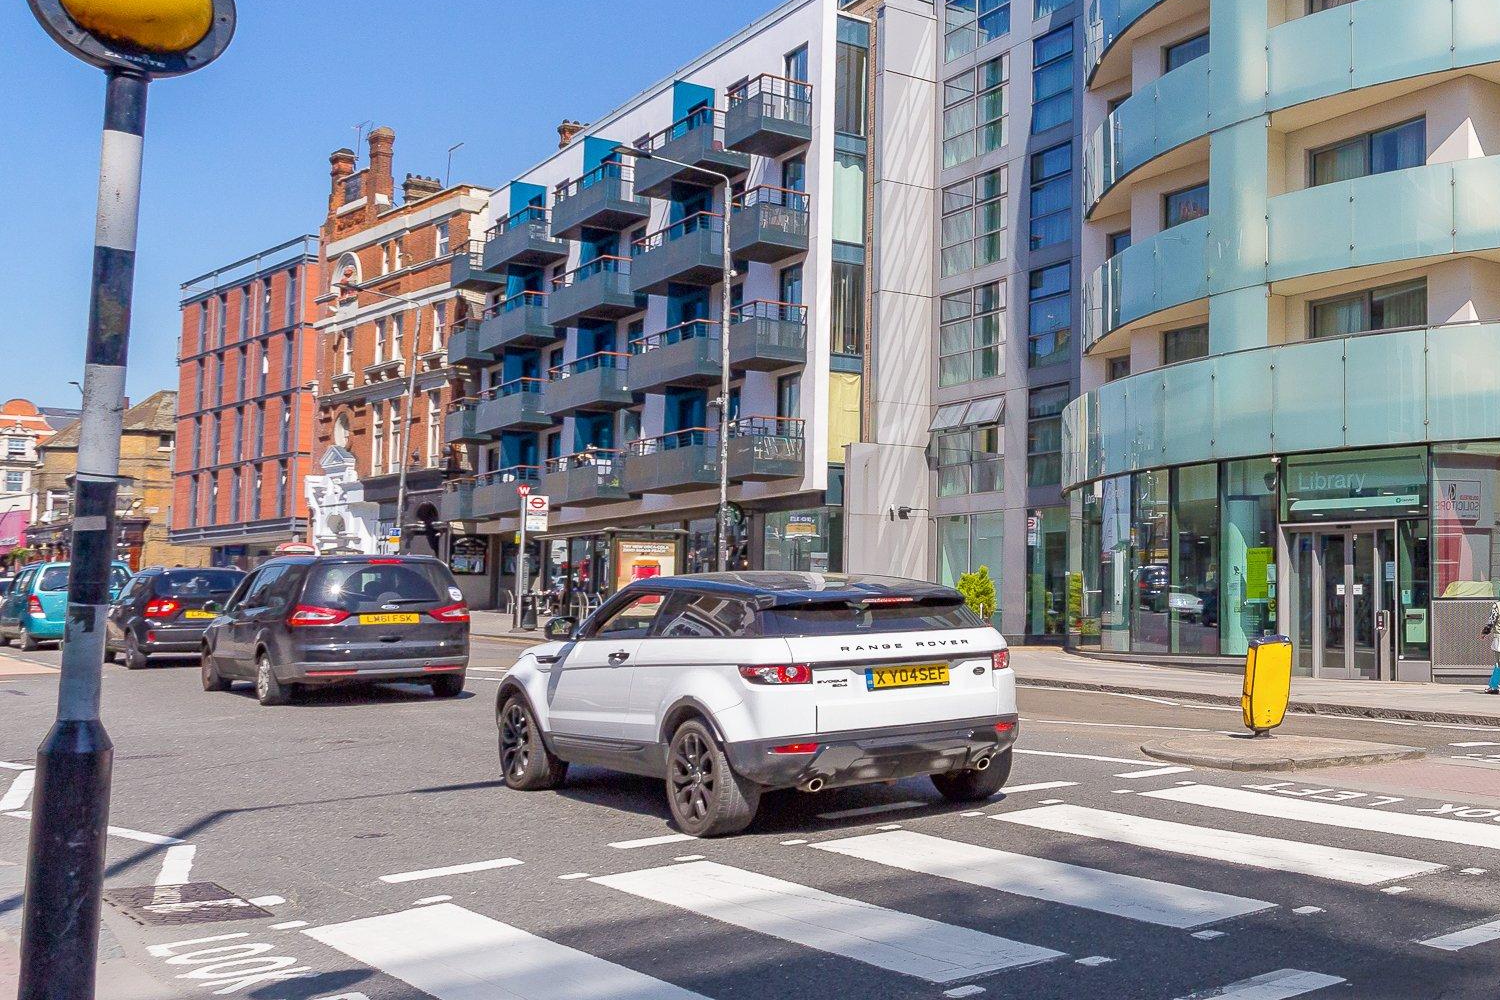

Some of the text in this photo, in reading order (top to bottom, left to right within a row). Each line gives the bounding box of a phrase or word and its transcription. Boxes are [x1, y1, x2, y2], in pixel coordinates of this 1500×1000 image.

[1299, 471, 1367, 493] Library
[840, 639, 969, 652] RANGE ROVER
